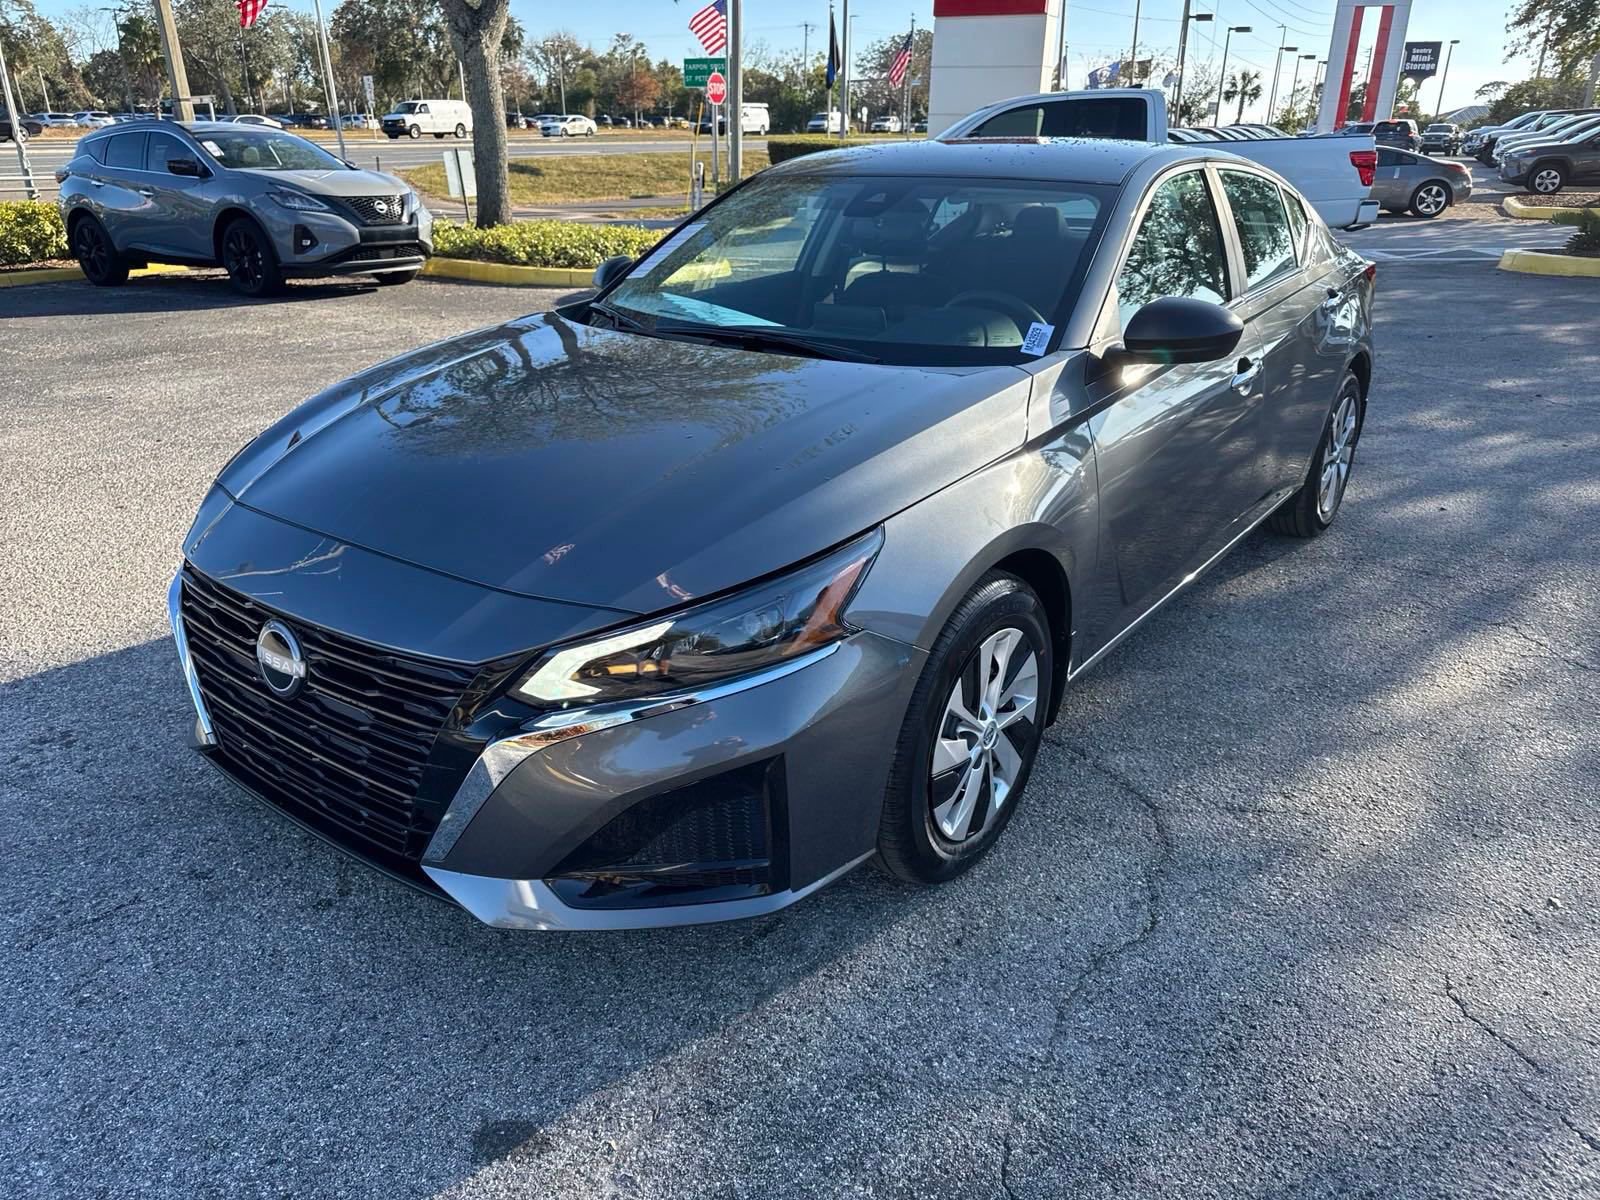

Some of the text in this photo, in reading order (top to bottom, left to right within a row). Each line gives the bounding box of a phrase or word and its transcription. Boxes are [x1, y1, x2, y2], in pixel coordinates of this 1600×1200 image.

[1405, 62, 1436, 70] Storage
[709, 83, 725, 95] STOP
[257, 644, 305, 676] NISSAN
